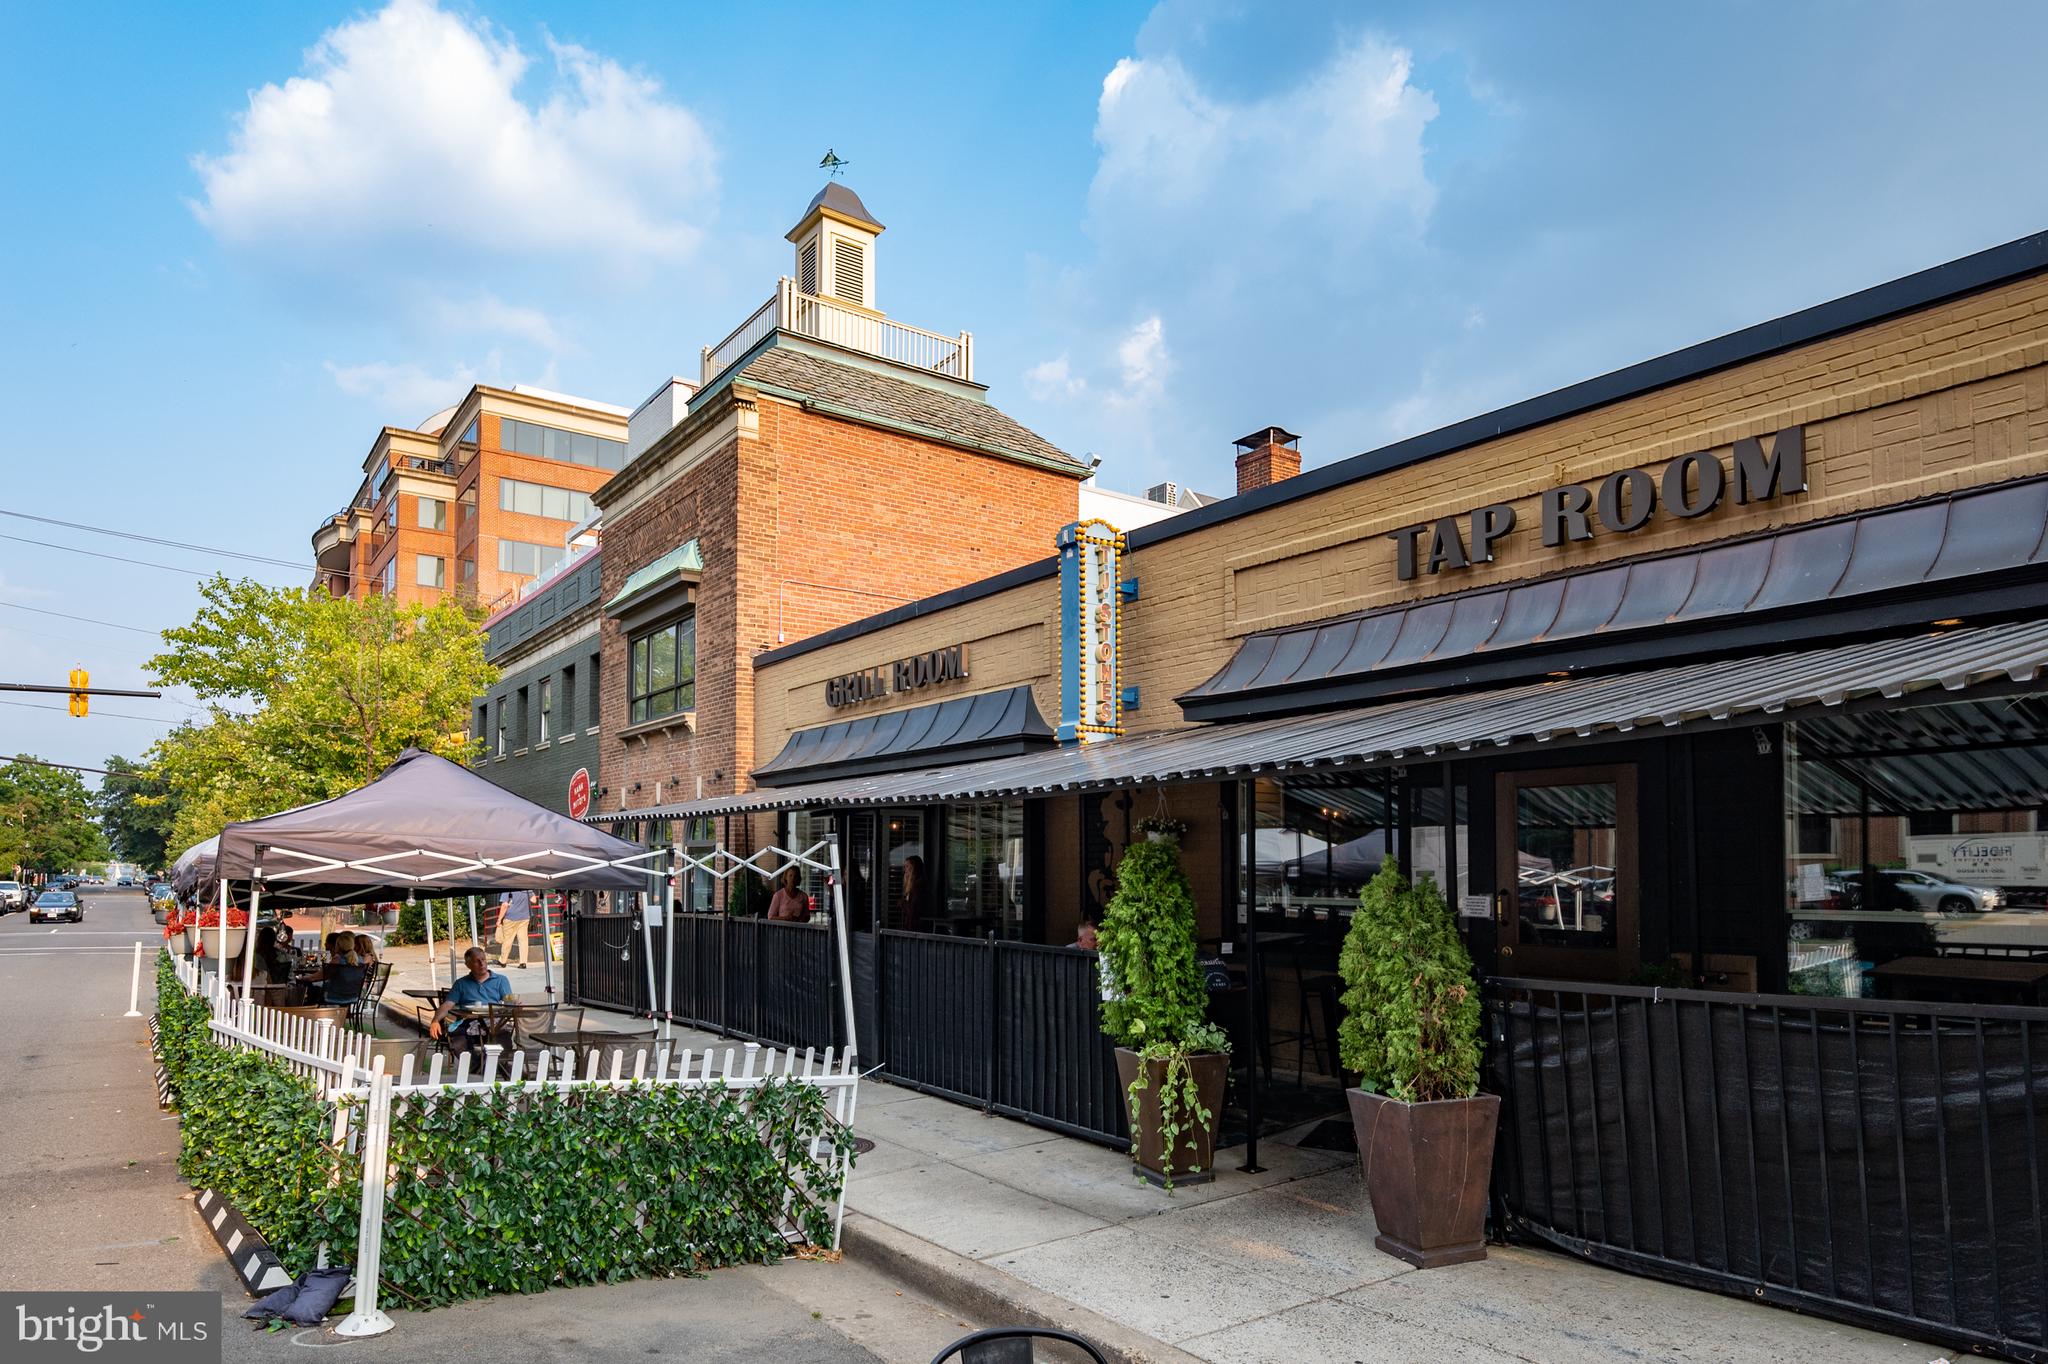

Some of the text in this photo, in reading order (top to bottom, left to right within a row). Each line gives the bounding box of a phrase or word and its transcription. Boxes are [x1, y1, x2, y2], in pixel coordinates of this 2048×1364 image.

[1388, 426, 1808, 581] TAP ROOM
[825, 643, 969, 708] GRILL ROOM
[1095, 602, 1113, 724] STONES
